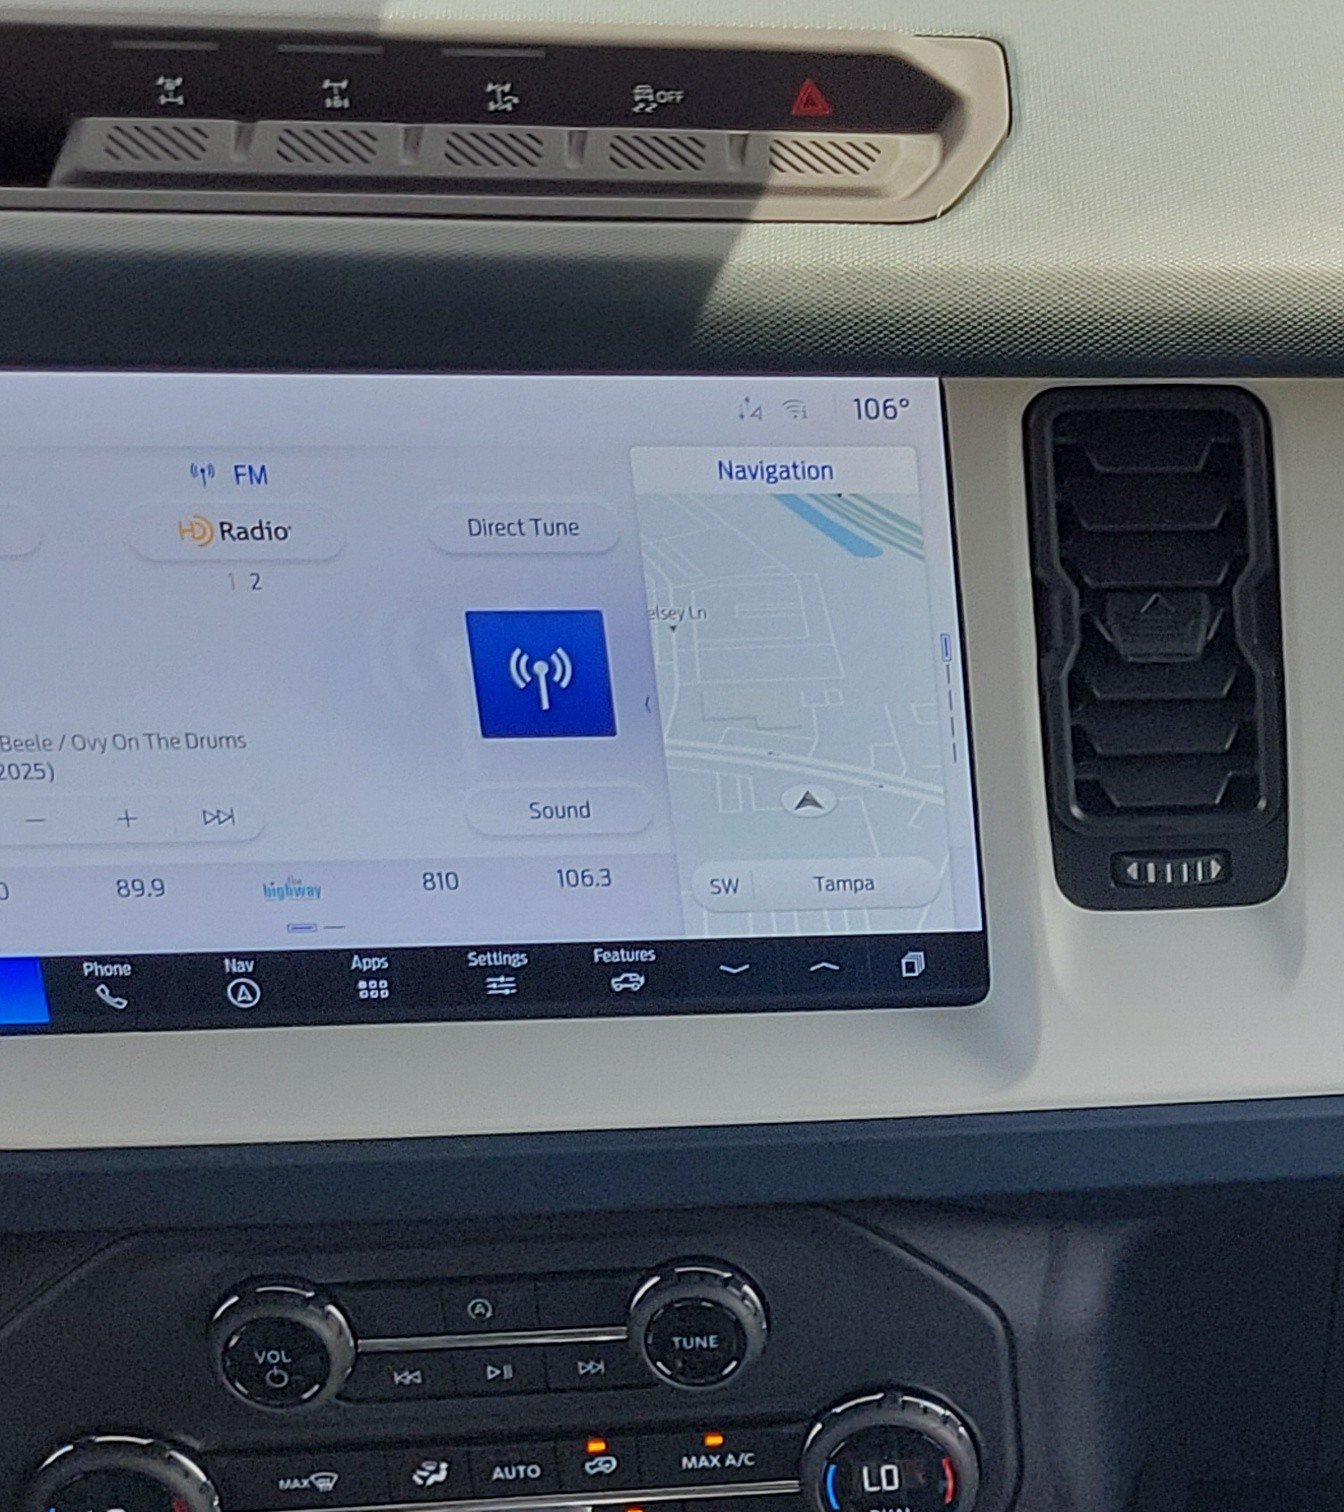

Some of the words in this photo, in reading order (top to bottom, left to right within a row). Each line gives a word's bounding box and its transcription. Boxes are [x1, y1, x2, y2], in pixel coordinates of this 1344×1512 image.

[655, 91, 684, 104] OFF
[852, 396, 910, 420] 106°
[233, 464, 268, 486] FM
[716, 459, 834, 485] Navigation
[219, 520, 290, 542] Radio
[467, 517, 525, 537] Direct
[528, 517, 580, 537] Tune
[249, 572, 262, 591] 2
[647, 605, 685, 622] elsey
[688, 605, 707, 619] Ln
[0, 735, 53, 753] Beele
[58, 735, 66, 752] /
[71, 734, 107, 754] Ovy
[112, 733, 140, 750] On
[143, 732, 181, 750] The
[185, 732, 247, 750] Drums
[0, 763, 54, 783] 2025)
[529, 801, 592, 821] Sound
[116, 878, 166, 898] 89.9
[422, 871, 459, 892] 810
[556, 868, 613, 889] 106.3
[709, 877, 740, 896] SW
[813, 875, 875, 895] Tampa
[263, 882, 321, 900] highway
[350, 955, 389, 971] Apps
[467, 950, 528, 969] Settings
[593, 947, 656, 964] Features
[83, 961, 132, 978] Phone
[224, 958, 254, 974] Nav
[671, 1334, 719, 1350] TUNE
[254, 1350, 291, 1365] VOL
[682, 1453, 721, 1470] MAX
[725, 1451, 755, 1468] A/C
[492, 1463, 541, 1480] AUTO
[862, 1463, 899, 1492] LO
[278, 1477, 310, 1490] MAX
